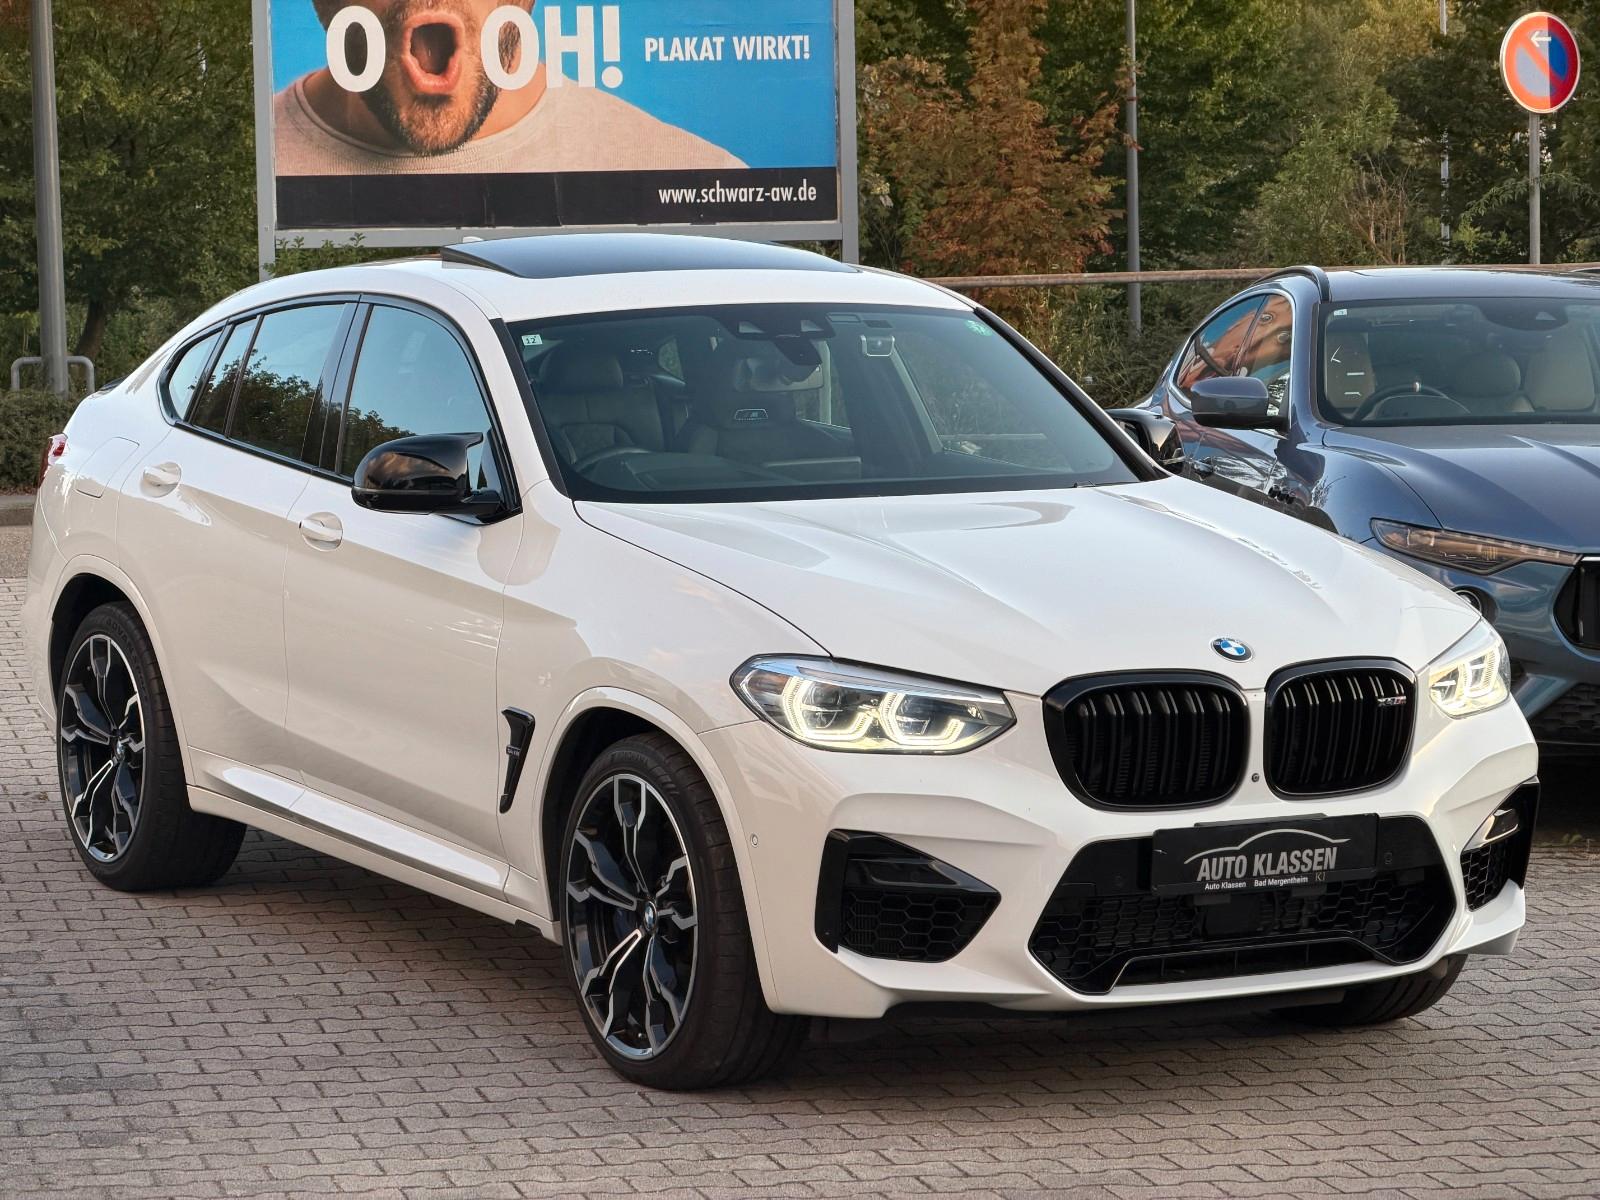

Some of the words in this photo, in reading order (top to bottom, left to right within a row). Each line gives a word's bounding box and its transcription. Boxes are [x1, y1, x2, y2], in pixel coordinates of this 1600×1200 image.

[644, 36, 725, 62] PLAKAT
[732, 35, 810, 61] WIRKT!
[658, 178, 817, 204] www.schwarz-aw.de
[1196, 855, 1247, 881] AUTO
[1252, 847, 1337, 876] KLASSEN
[1204, 882, 1220, 890] Auto
[1221, 881, 1247, 889] Klassen
[1254, 878, 1267, 887] Bad
[1267, 875, 1309, 887] Mergentheim
